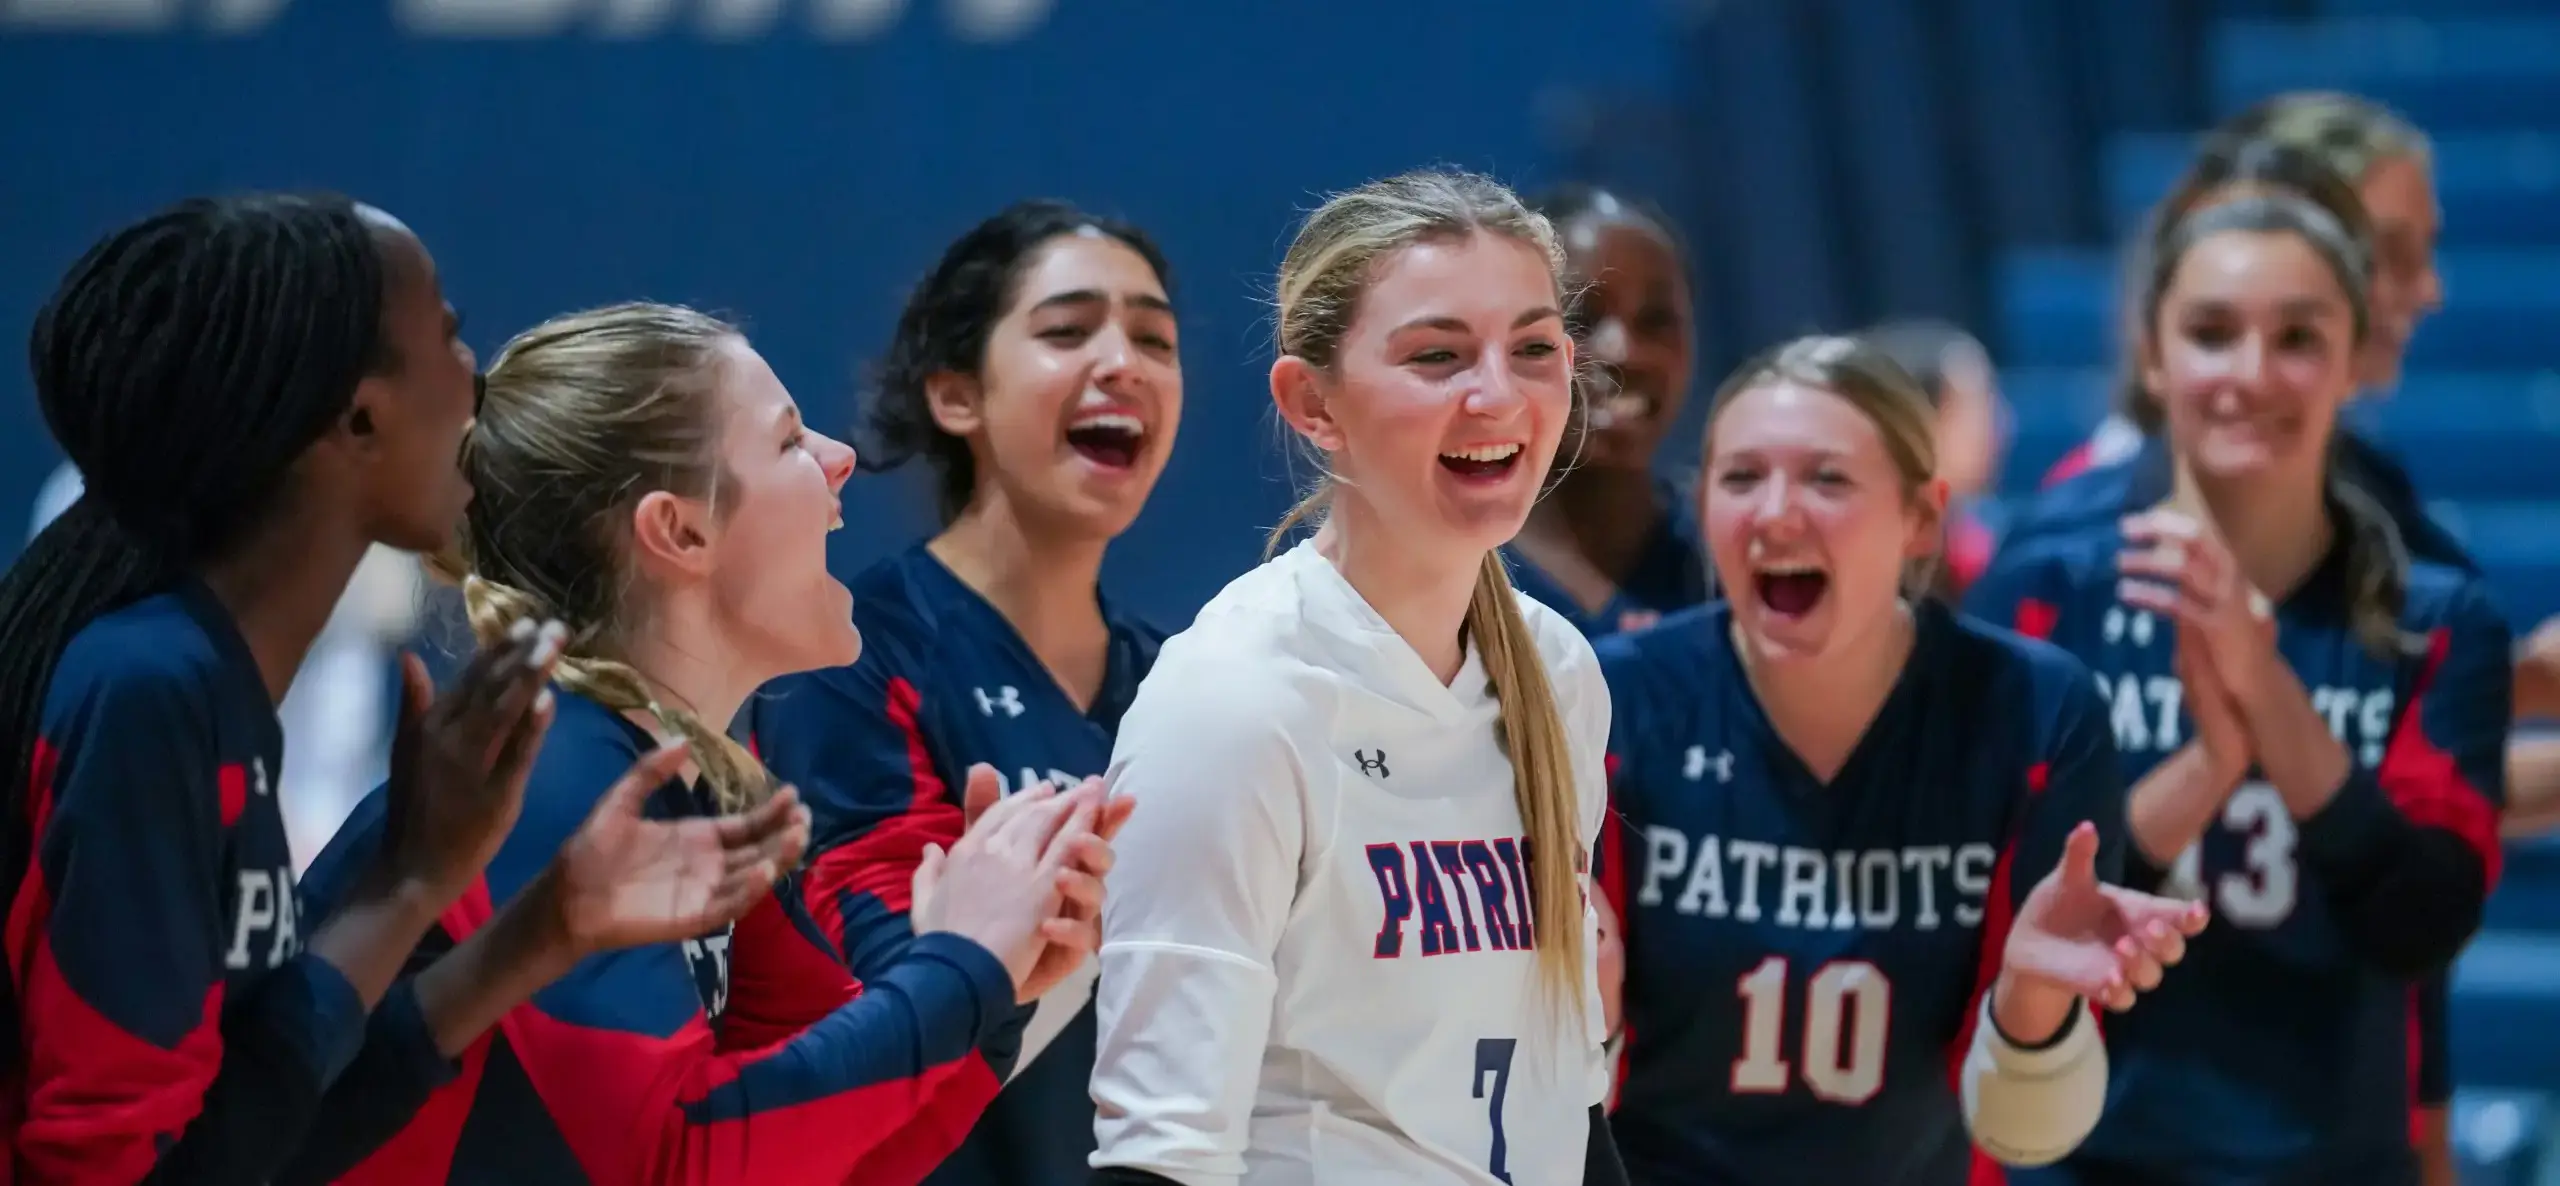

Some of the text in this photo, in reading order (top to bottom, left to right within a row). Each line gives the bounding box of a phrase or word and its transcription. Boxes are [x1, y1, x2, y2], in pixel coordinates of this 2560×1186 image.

[1365, 836, 1588, 958] PATRI
[1637, 825, 1996, 930] PATRIOTS
[1730, 955, 1892, 1106] 10
[1473, 1038, 1517, 1186] 7
